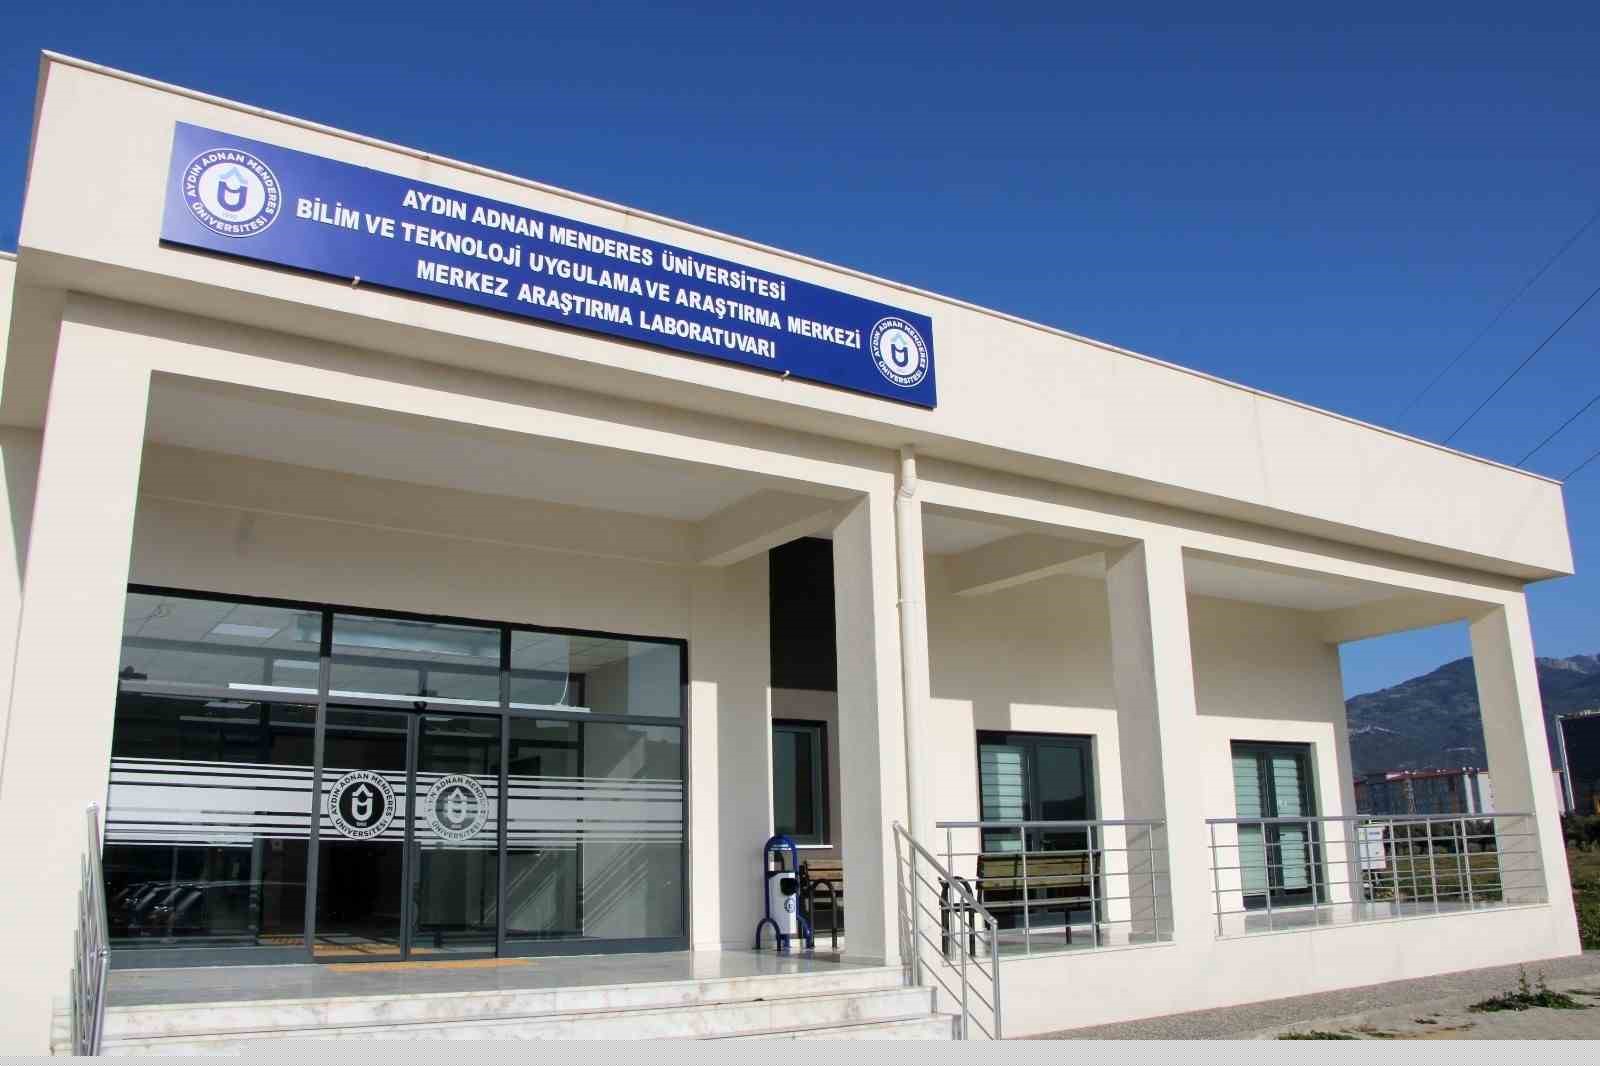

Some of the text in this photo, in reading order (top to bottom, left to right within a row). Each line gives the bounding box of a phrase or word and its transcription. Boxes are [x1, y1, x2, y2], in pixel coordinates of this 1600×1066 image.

[186, 152, 277, 215] AYDIN ADNAN MENDERES
[296, 197, 861, 349] BİLİM VE TEKNOLOJİ UYGULAMA VE ARAŞTIRMA MERKEZİ
[402, 188, 786, 301] AYDIN ADNAN MENDERES ÜNİVERSİTESİ
[416, 259, 776, 359] MERKEZ ARAŞTIRMA LABORATUVARI
[330, 788, 341, 816] AYDIN
[340, 774, 369, 789] ADNAN
[371, 775, 394, 817] MENDERES
